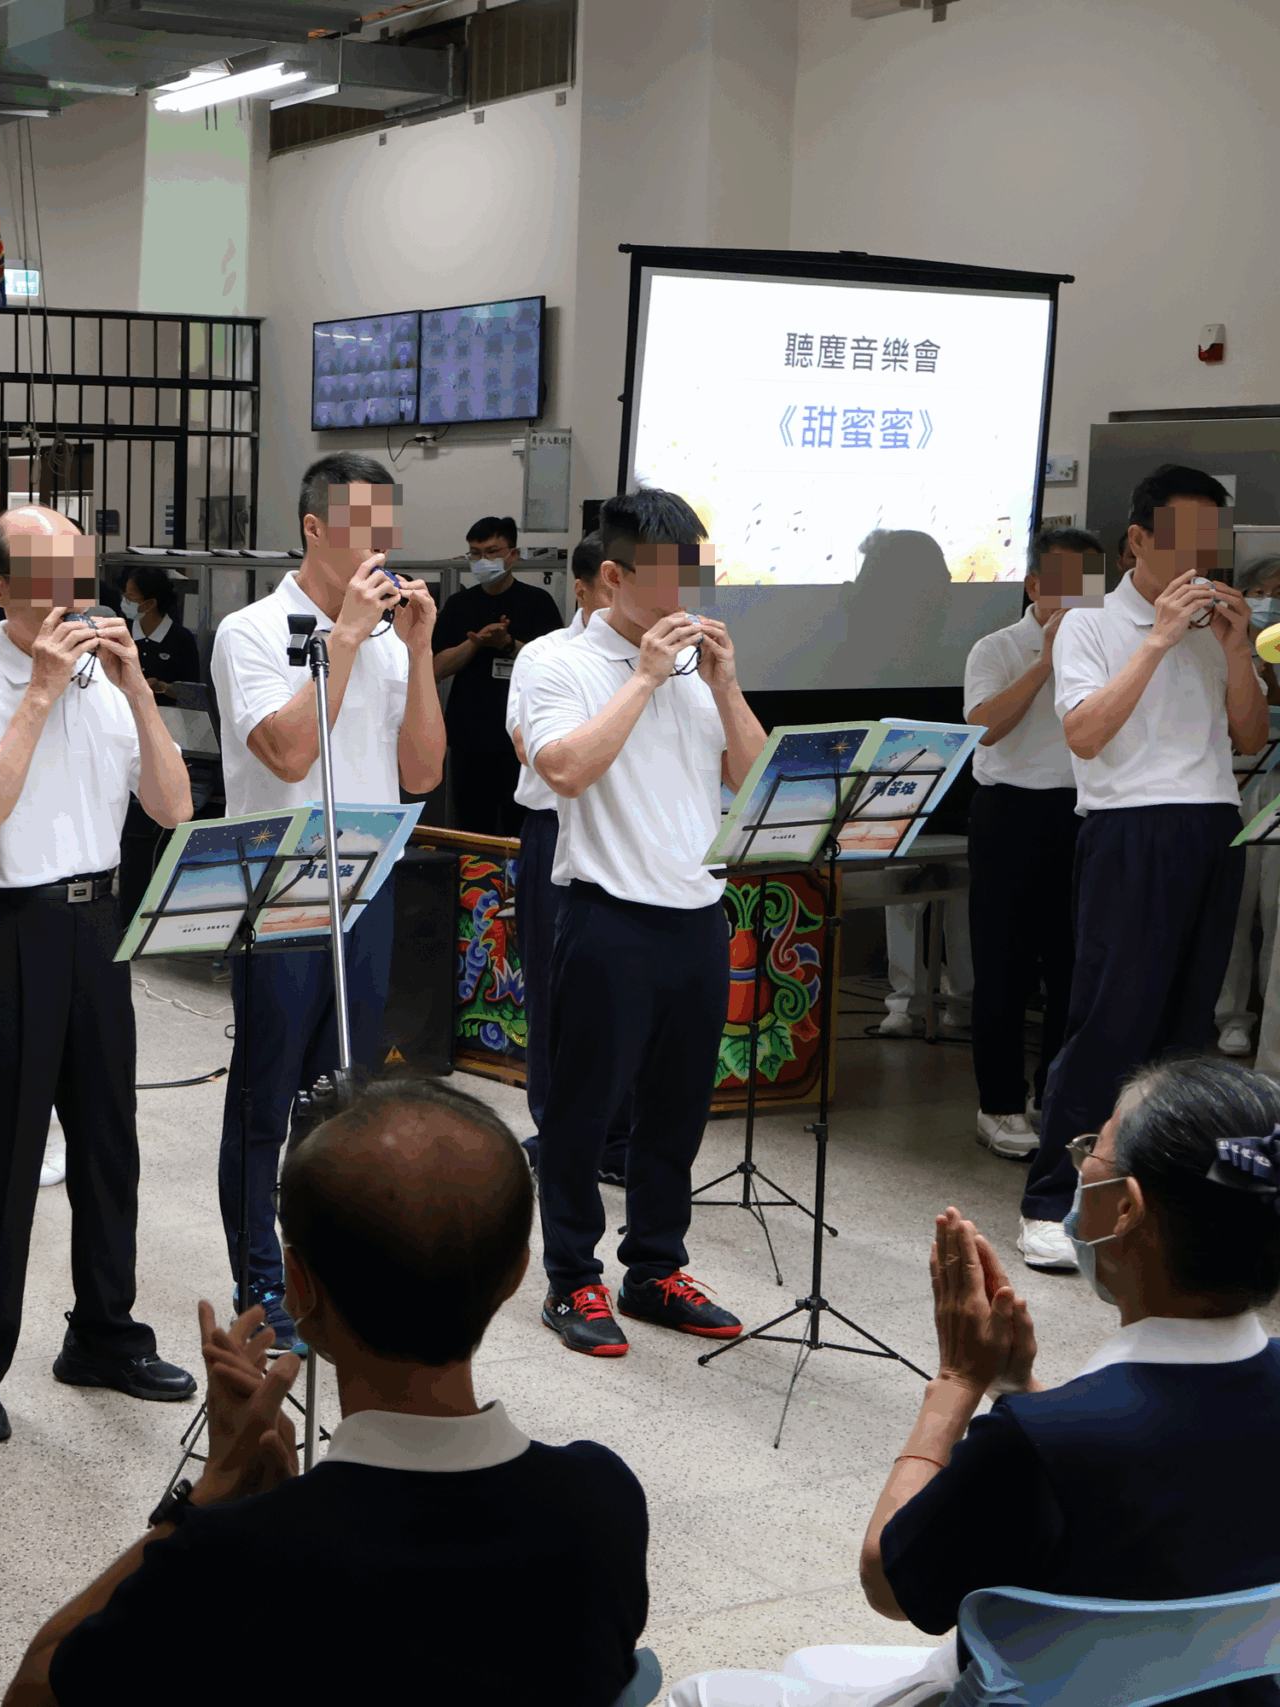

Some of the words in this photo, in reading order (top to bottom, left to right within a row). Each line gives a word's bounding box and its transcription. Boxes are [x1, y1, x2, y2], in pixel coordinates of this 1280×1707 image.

[784, 332, 942, 374] 聽塵音樂會
[778, 405, 935, 450] 《甜蜜蜜》
